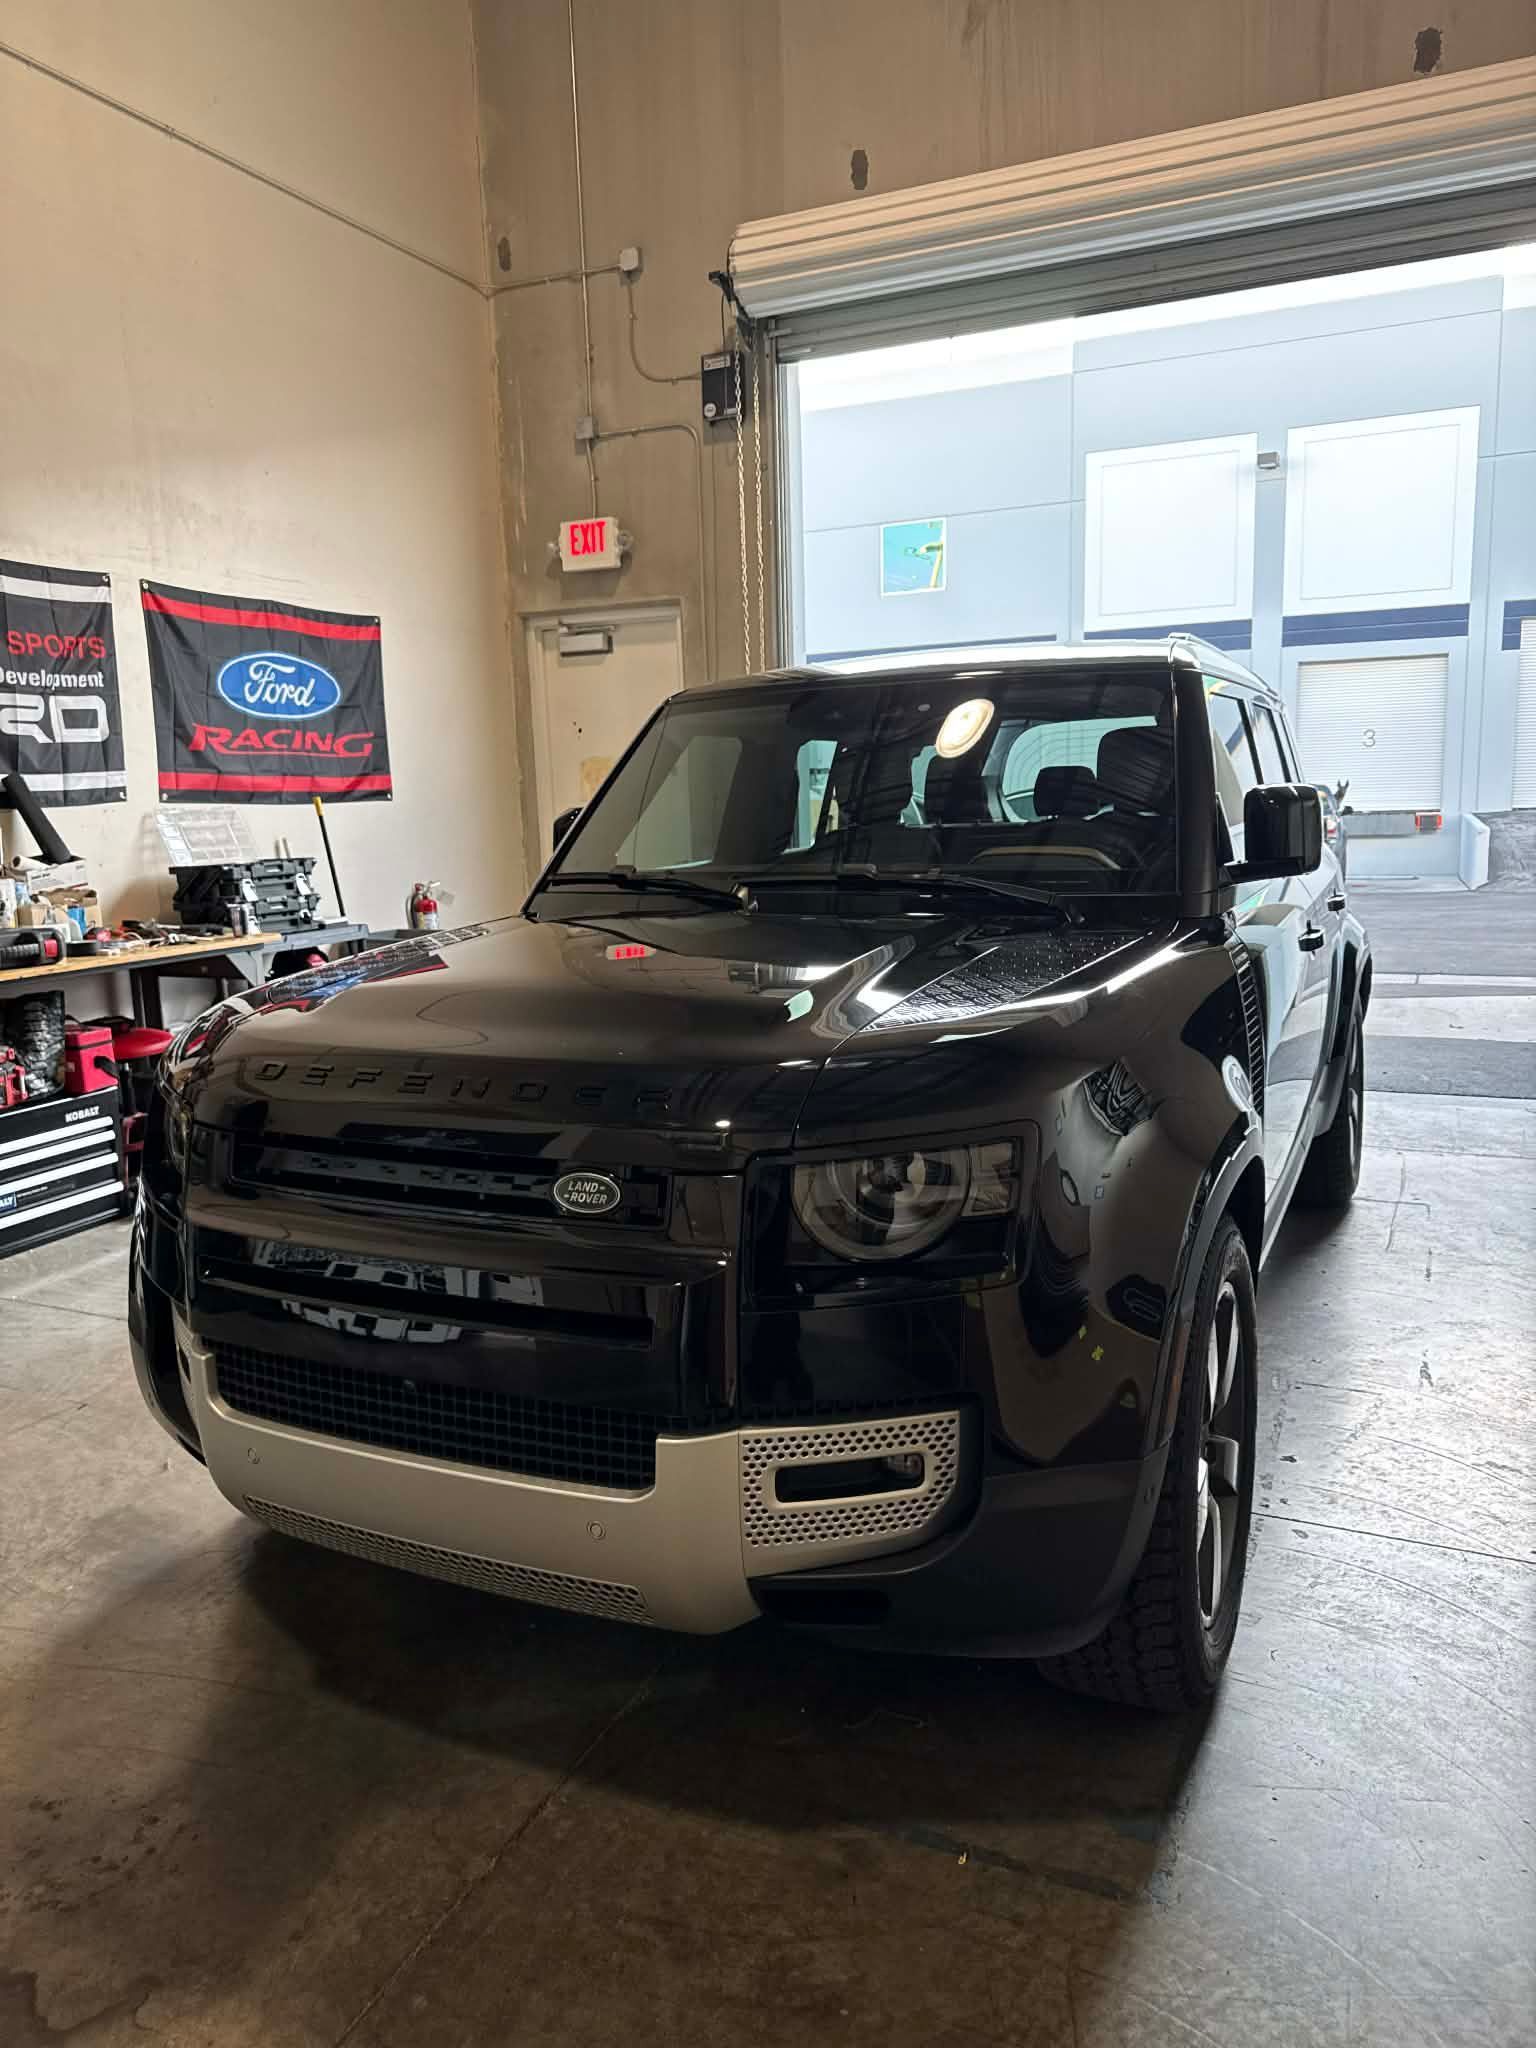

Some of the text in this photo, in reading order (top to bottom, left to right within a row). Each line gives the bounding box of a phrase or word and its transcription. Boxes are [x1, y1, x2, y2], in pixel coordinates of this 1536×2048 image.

[569, 520, 606, 555] EXIT
[8, 630, 107, 659] SPORTS
[244, 660, 316, 707] Ford
[190, 722, 375, 758] RACING
[1363, 728, 1376, 748] 3
[254, 1060, 673, 1112] DEFENDER
[65, 1106, 100, 1123] KOBALT
